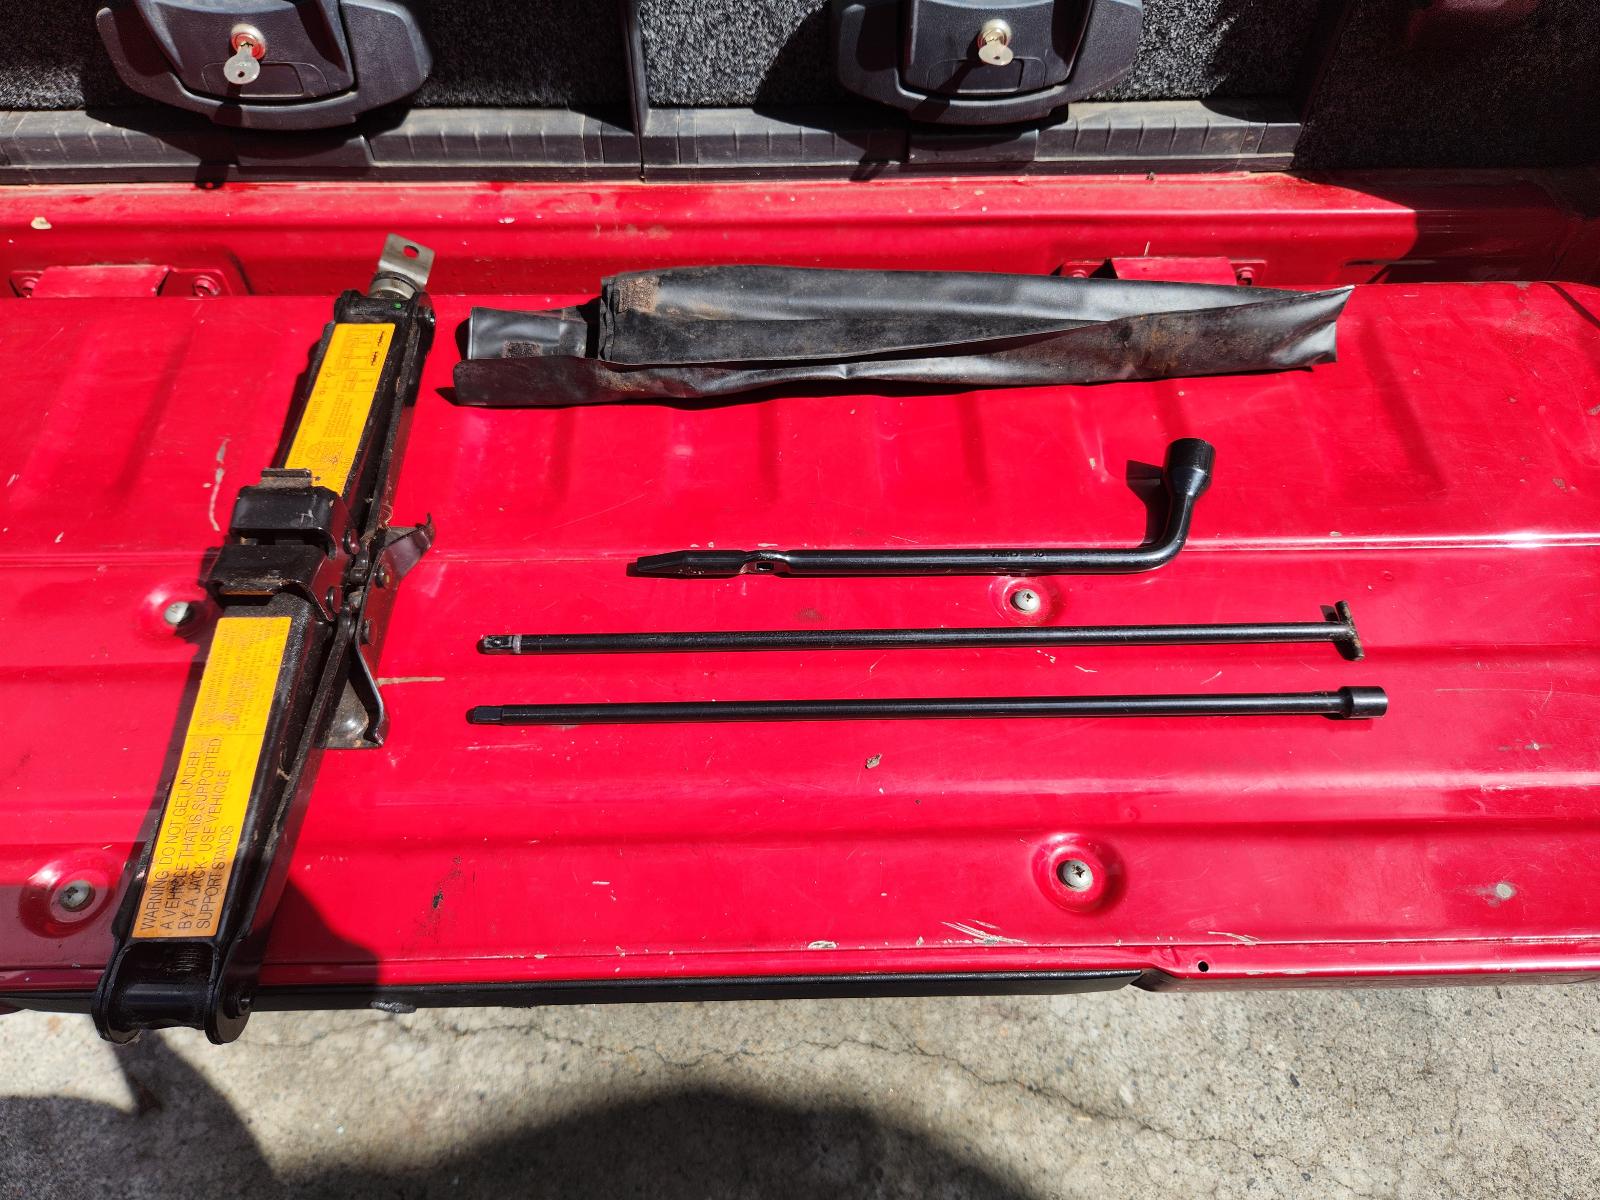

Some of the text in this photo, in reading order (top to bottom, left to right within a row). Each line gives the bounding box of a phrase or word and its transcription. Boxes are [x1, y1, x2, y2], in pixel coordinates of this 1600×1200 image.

[178, 751, 200, 790] UNDER
[173, 794, 190, 816] GET
[205, 769, 232, 823] VEHICLE
[164, 820, 183, 844] NOT
[186, 815, 202, 825] IS
[178, 830, 198, 858] THAT
[198, 826, 216, 852] USE
[158, 847, 175, 864] DO
[196, 825, 233, 929] SUPPORT STANDS
[161, 864, 189, 918] VEHICLE
[184, 898, 198, 907] A
[160, 921, 174, 930] A
[178, 912, 195, 929] BY
